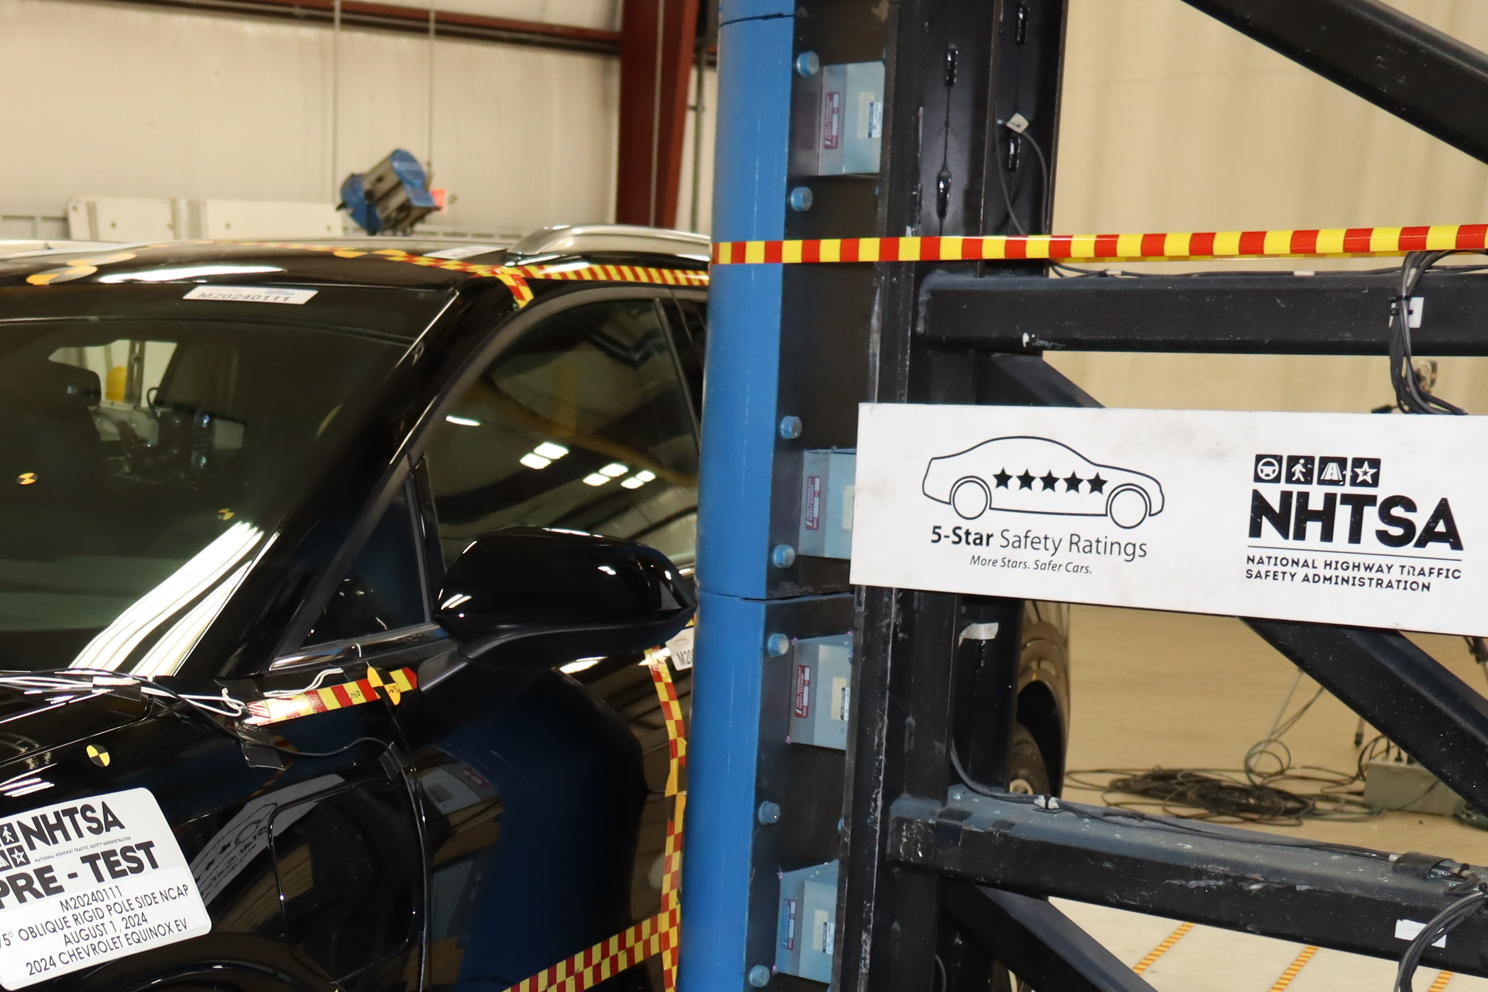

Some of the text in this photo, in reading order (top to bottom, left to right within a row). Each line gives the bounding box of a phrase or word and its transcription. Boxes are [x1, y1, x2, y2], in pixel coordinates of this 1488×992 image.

[197, 292, 290, 302] M20240111
[1248, 488, 1464, 551] NHTSA
[930, 525, 1148, 563] 5-Star Safety Ratings
[969, 555, 1092, 574] More Stars. Safer Cars.
[1245, 569, 1431, 592] SAFETY ADMINISTRATION
[1246, 554, 1462, 579] NATIONAL HIGHWAY TRAFFIC
[16, 800, 125, 851] NHTSA
[80, 840, 160, 883] TEST
[18, 916, 72, 942] OBLIQUE
[71, 907, 105, 926] RIGID
[106, 898, 135, 916] POLE
[135, 892, 162, 909] SIDE
[159, 884, 189, 902] NCAP
[59, 885, 123, 913] M20240111
[26, 918, 188, 976] 2024 CHEVROLET EQUINOX EV
[63, 922, 107, 947] AUGUST
[121, 912, 149, 930] 2024
